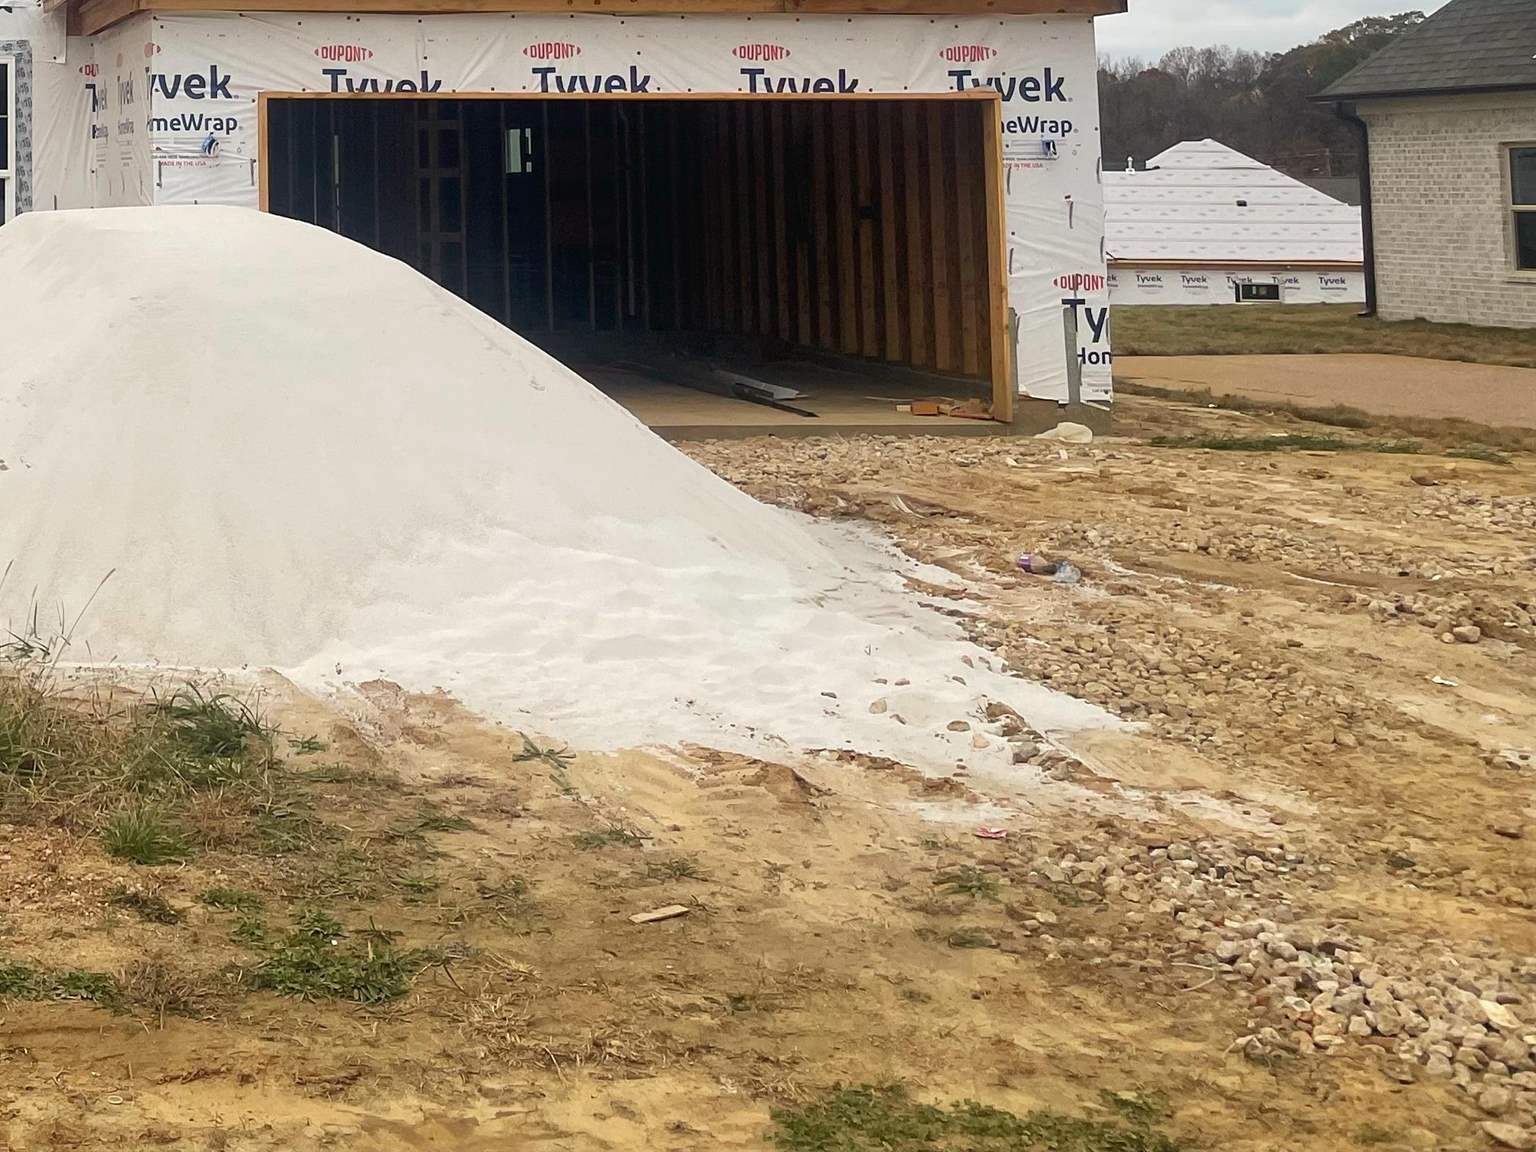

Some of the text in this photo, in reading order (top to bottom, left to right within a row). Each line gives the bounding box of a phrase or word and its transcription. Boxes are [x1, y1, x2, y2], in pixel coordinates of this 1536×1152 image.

[321, 45, 367, 62] DUPONT
[530, 43, 575, 59] DUPONT
[739, 44, 786, 61] DUPONT
[946, 44, 991, 62] DUPONT
[1060, 273, 1105, 291] DUPONT
[1272, 276, 1299, 285] Tvek
